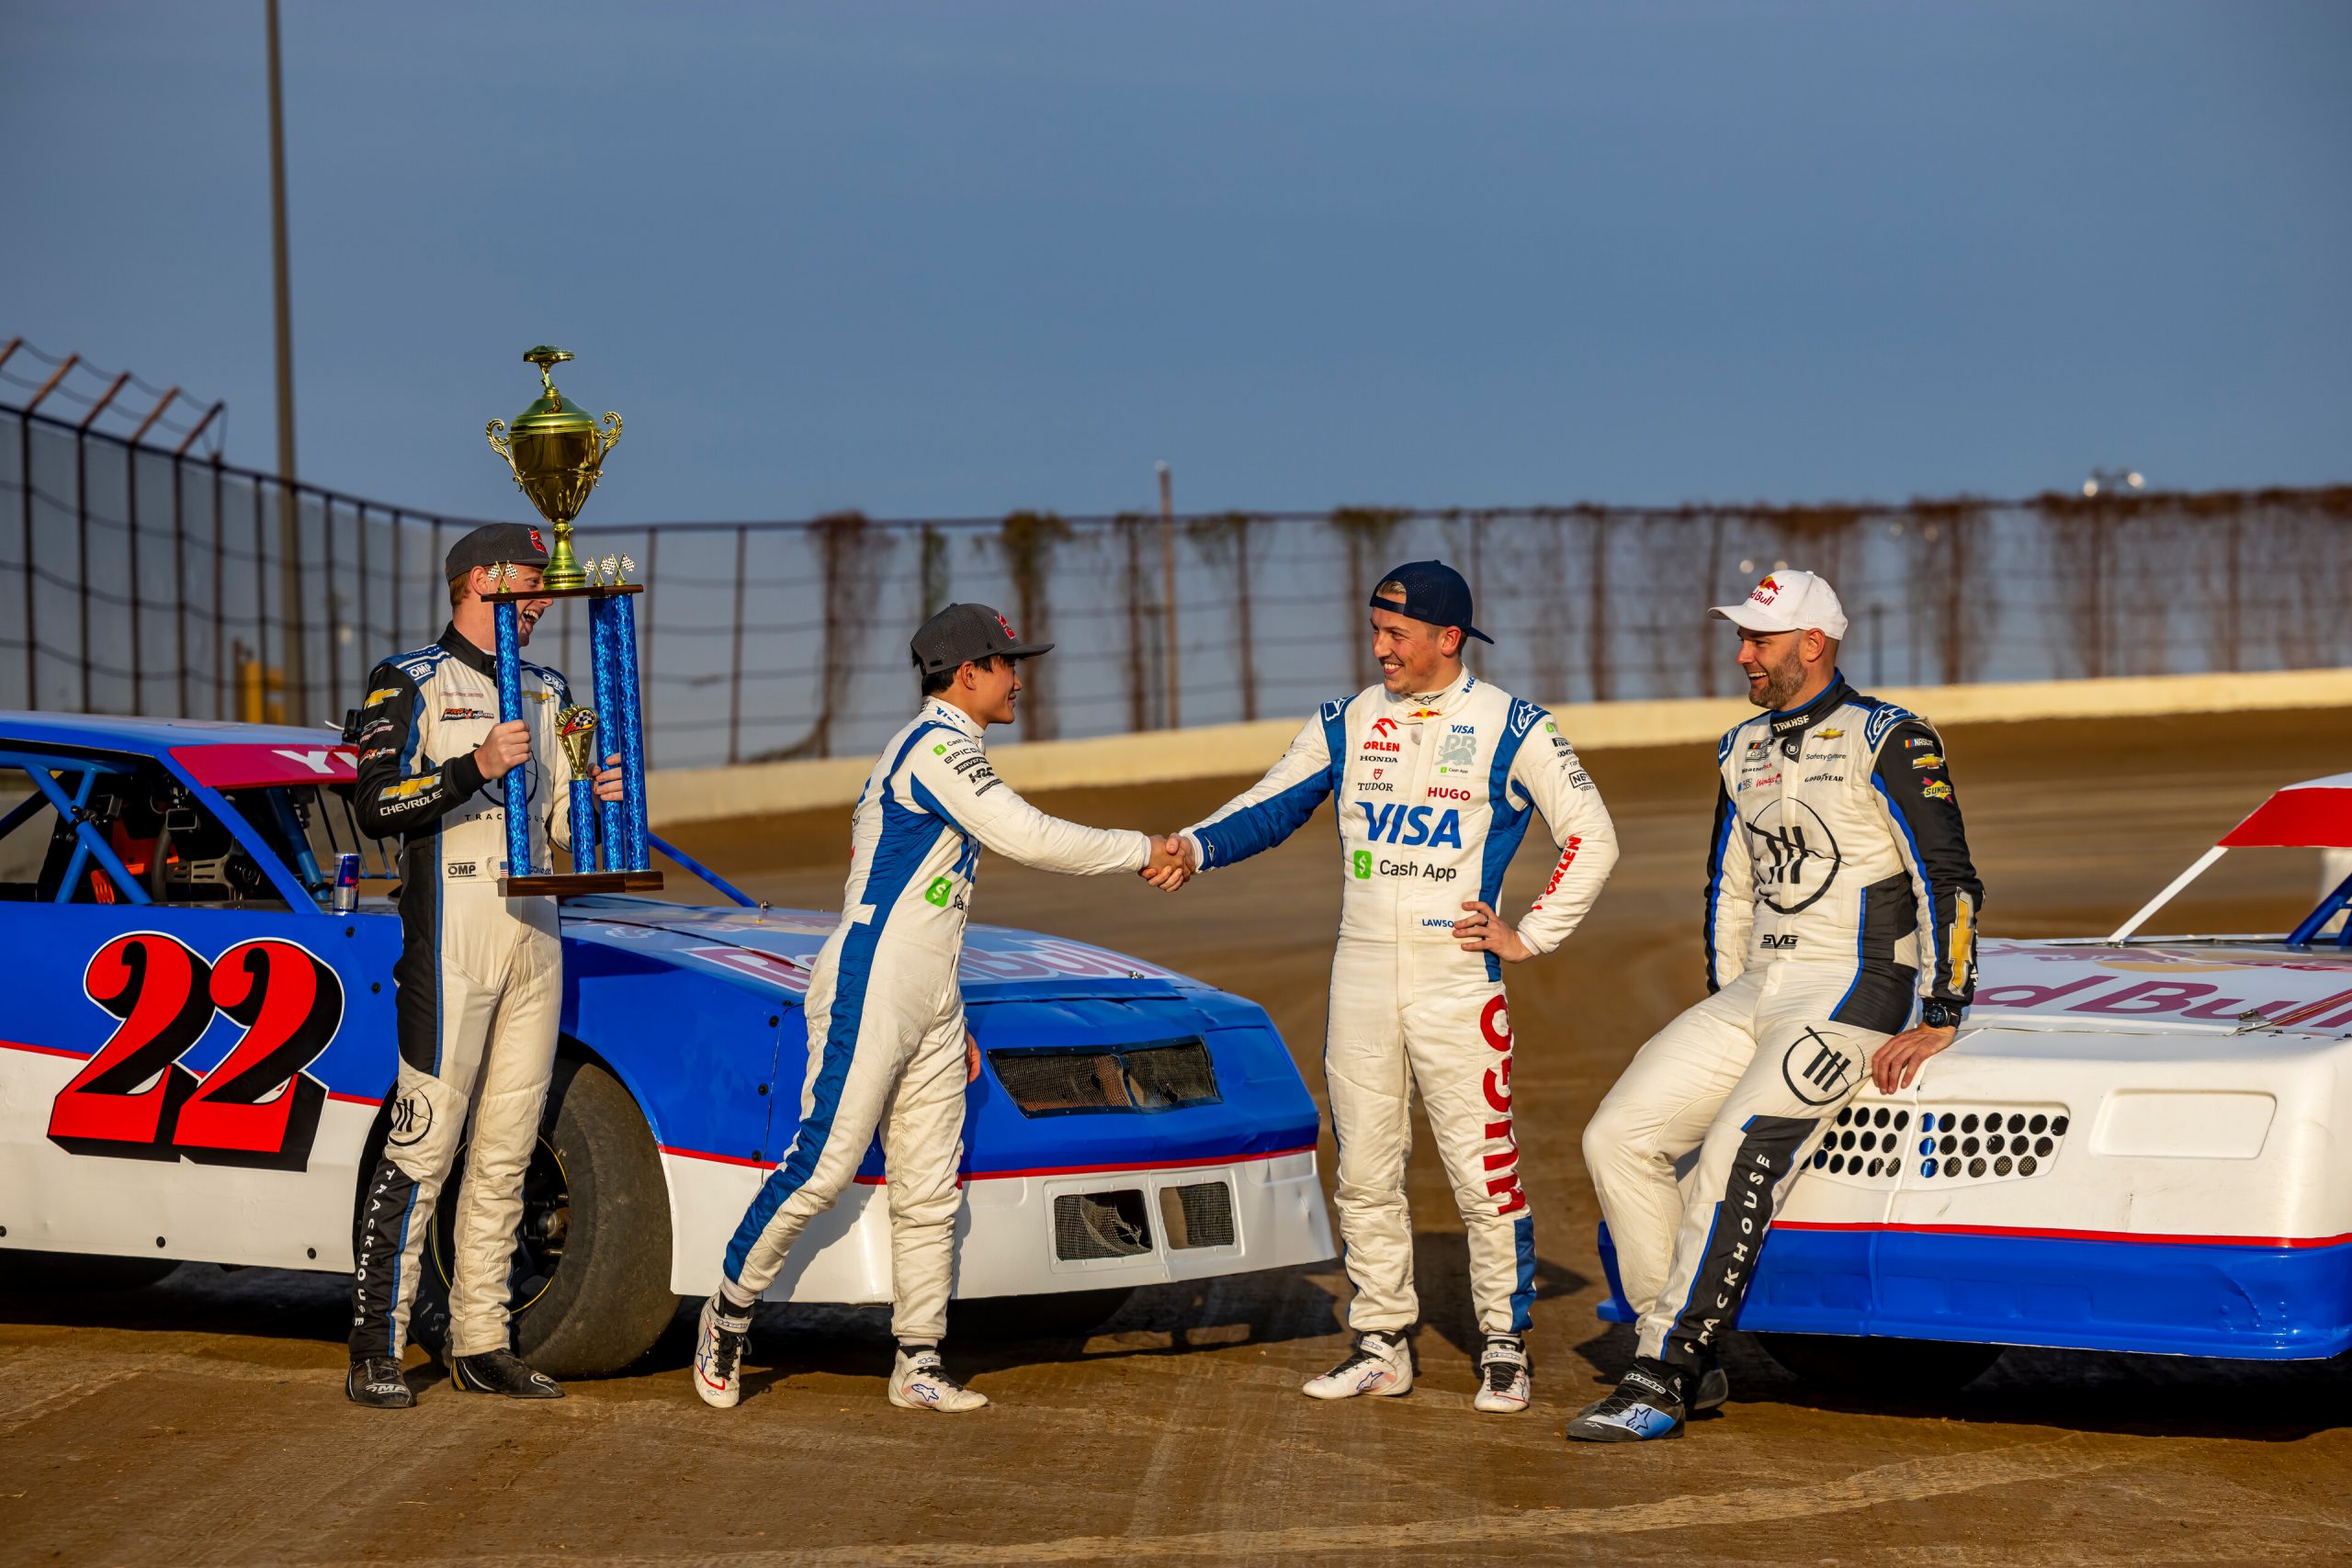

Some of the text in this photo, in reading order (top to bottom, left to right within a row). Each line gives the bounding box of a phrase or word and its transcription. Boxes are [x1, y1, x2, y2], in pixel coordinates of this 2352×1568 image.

[410, 663, 432, 677] OMP
[1451, 725, 1475, 734] VISA
[1363, 741, 1400, 752] ORLEN
[1804, 773, 1844, 783] GOODYEAR
[1358, 783, 1394, 792] TUDOR
[1427, 787, 1471, 801] HUGO
[379, 788, 443, 817] CHEVROLE
[1354, 801, 1462, 850] VISA
[447, 865, 477, 875] OMP
[1379, 859, 1419, 877] Cash
[1422, 863, 1457, 883] App
[1544, 836, 1582, 896] ORLEN
[1421, 919, 1454, 928] LAWSO
[1760, 933, 1800, 950] SVG
[48, 931, 344, 1172] 22
[355, 1168, 396, 1326] TRACKHOUSE
